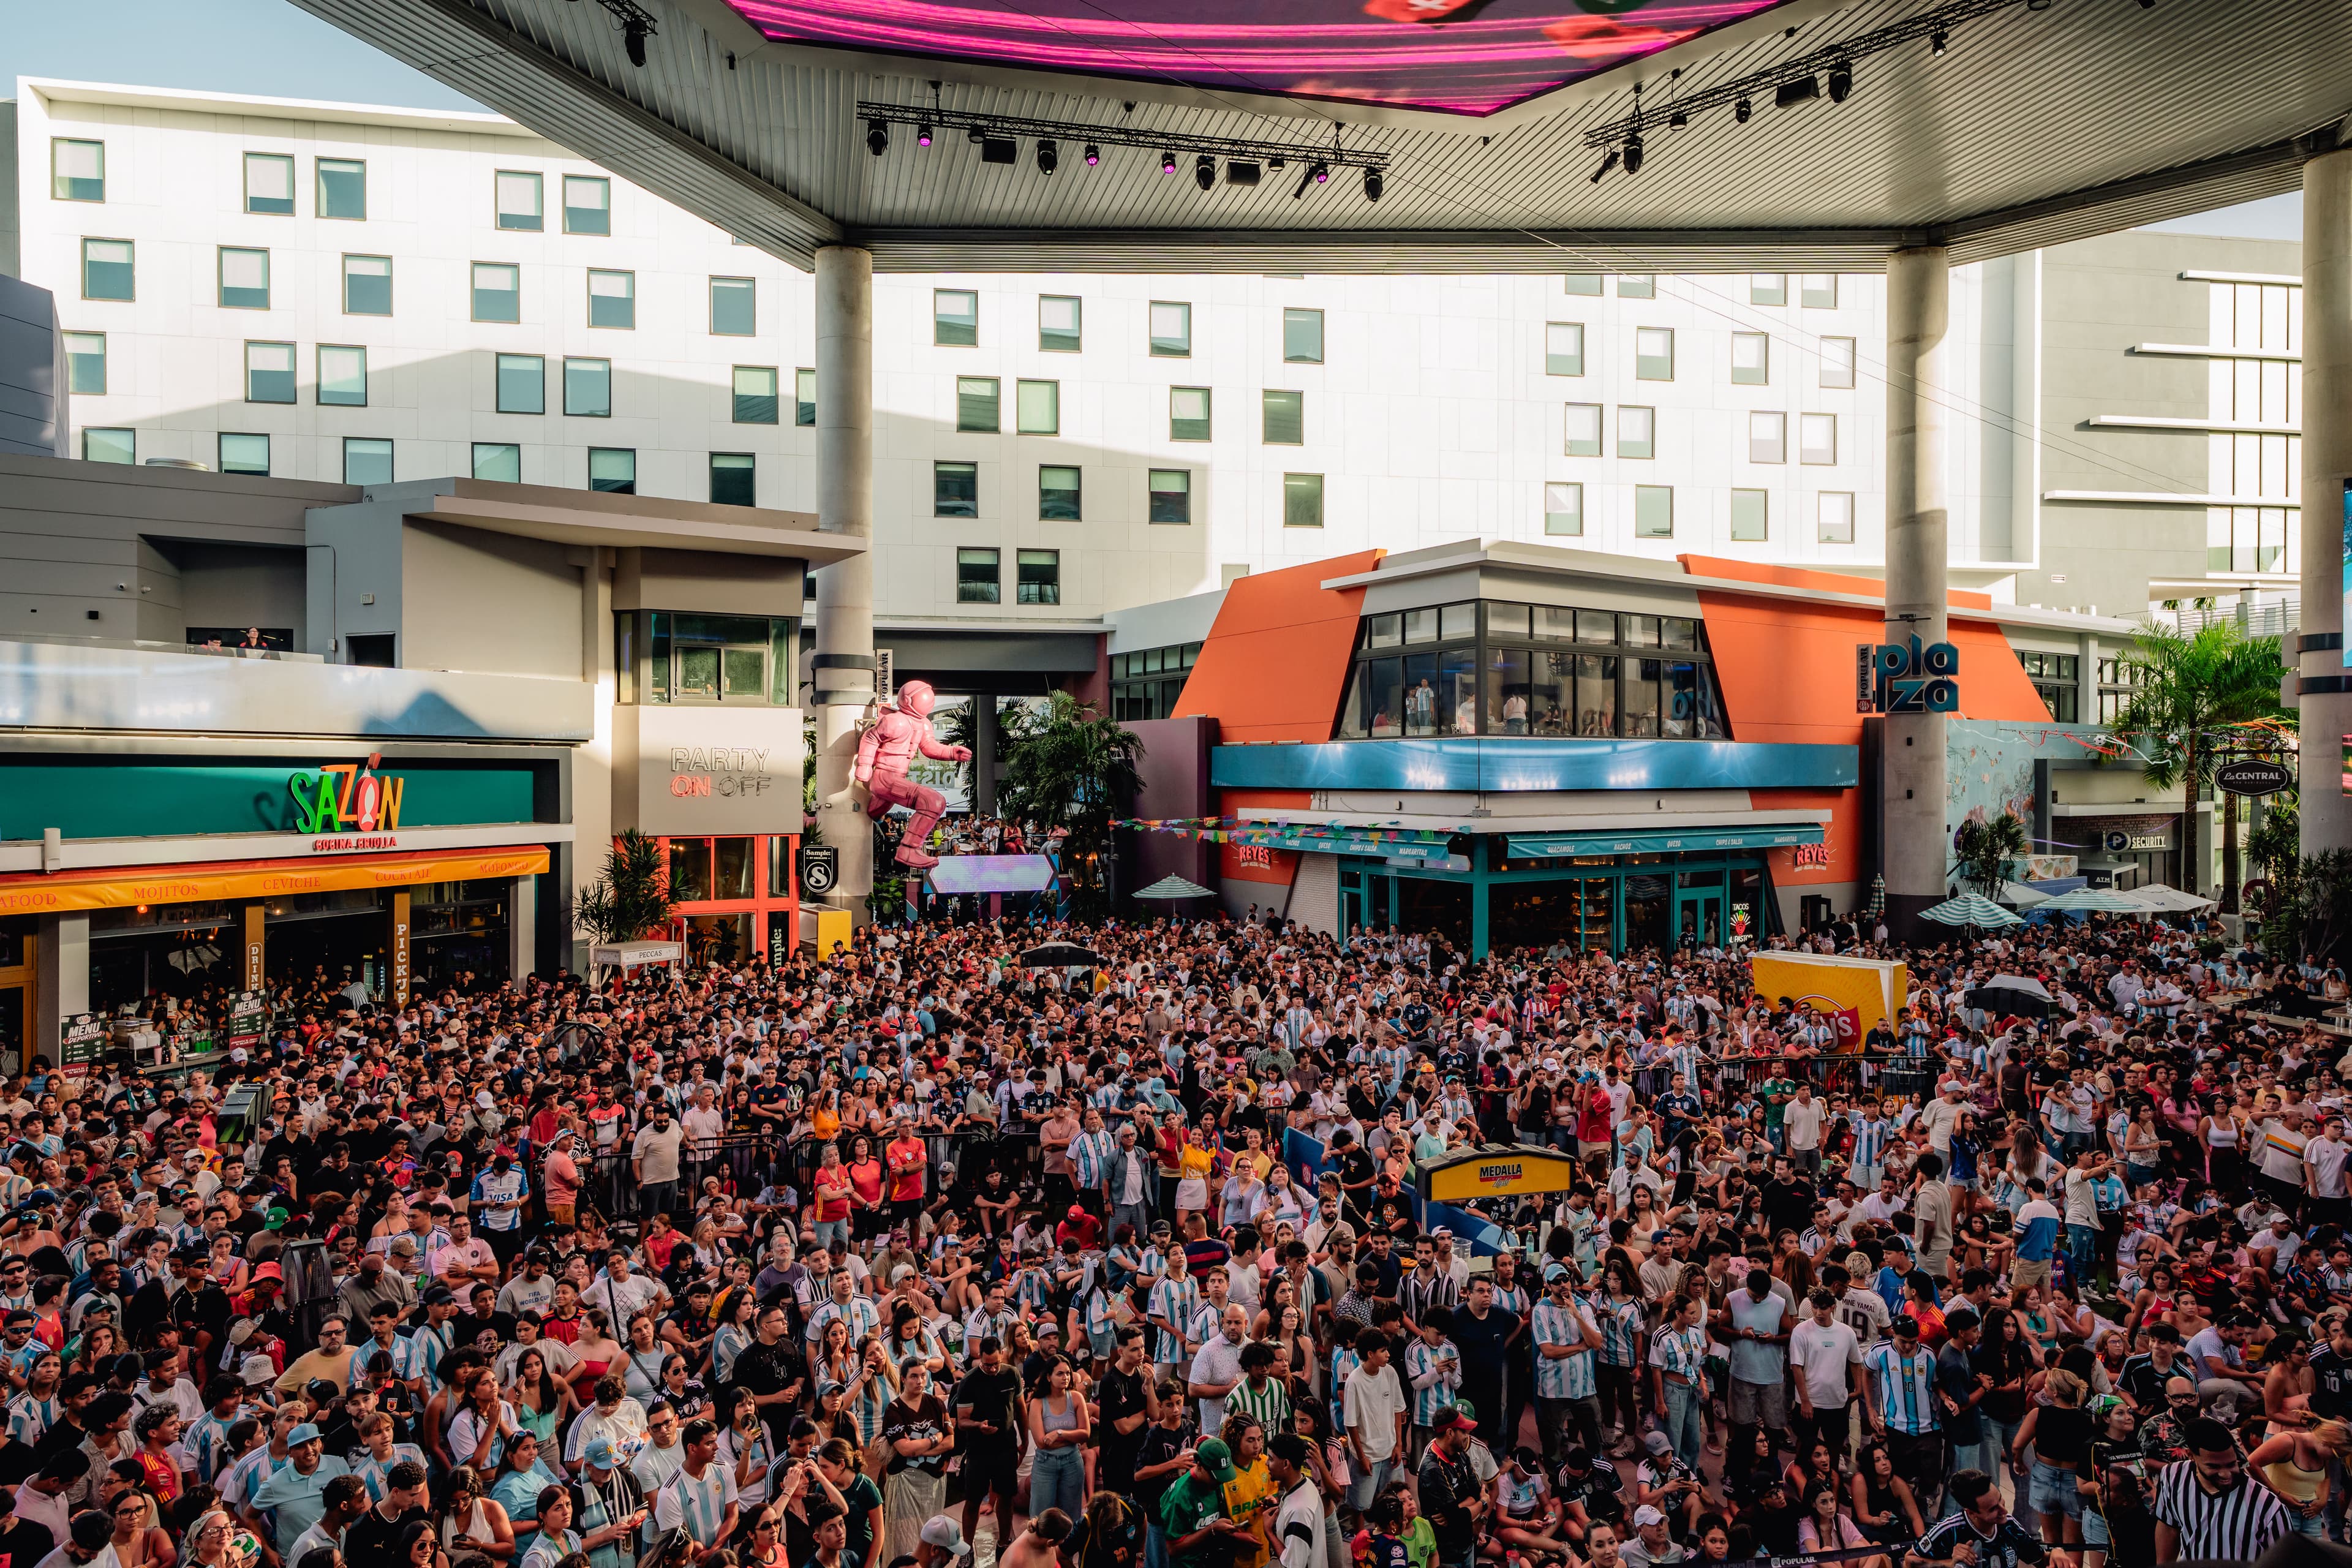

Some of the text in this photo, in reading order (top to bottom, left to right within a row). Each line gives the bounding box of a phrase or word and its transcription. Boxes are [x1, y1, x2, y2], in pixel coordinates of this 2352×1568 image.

[671, 747, 769, 772] PARTY
[671, 775, 771, 797] ON OFF
[314, 837, 397, 851] COCINA CRIOLLA
[1667, 840, 1681, 848] QUESO
[2113, 835, 2165, 847] P SECURITY
[1239, 845, 1269, 864] REYES
[1399, 847, 1427, 856] MARGARITAS
[1795, 848, 1829, 865] REYES
[480, 861, 529, 873] MOFONGO
[375, 869, 432, 882] COCKTAIL
[809, 867, 827, 886] S
[263, 876, 321, 890] CEVICHE
[134, 884, 199, 900] MOJITOS
[639, 950, 662, 959] PECCAS
[396, 924, 407, 1003] PICKUP
[235, 1008, 262, 1018] DEPORTIVO
[68, 1031, 102, 1044] DEPORTIVO
[1480, 1164, 1522, 1177] MEDALLA
[1493, 1177, 1512, 1188] Light
[489, 1193, 513, 1202] VISA
[1580, 1227, 1591, 1243] 36
[519, 1297, 539, 1306] WORLD
[1856, 1300, 1875, 1313] YAMAL
[1178, 1304, 1188, 1318] 10
[1842, 1308, 1868, 1341] 19
[1904, 1381, 1913, 1392] 10
[2324, 1375, 2340, 1392] 10
[607, 1445, 614, 1455] NY
